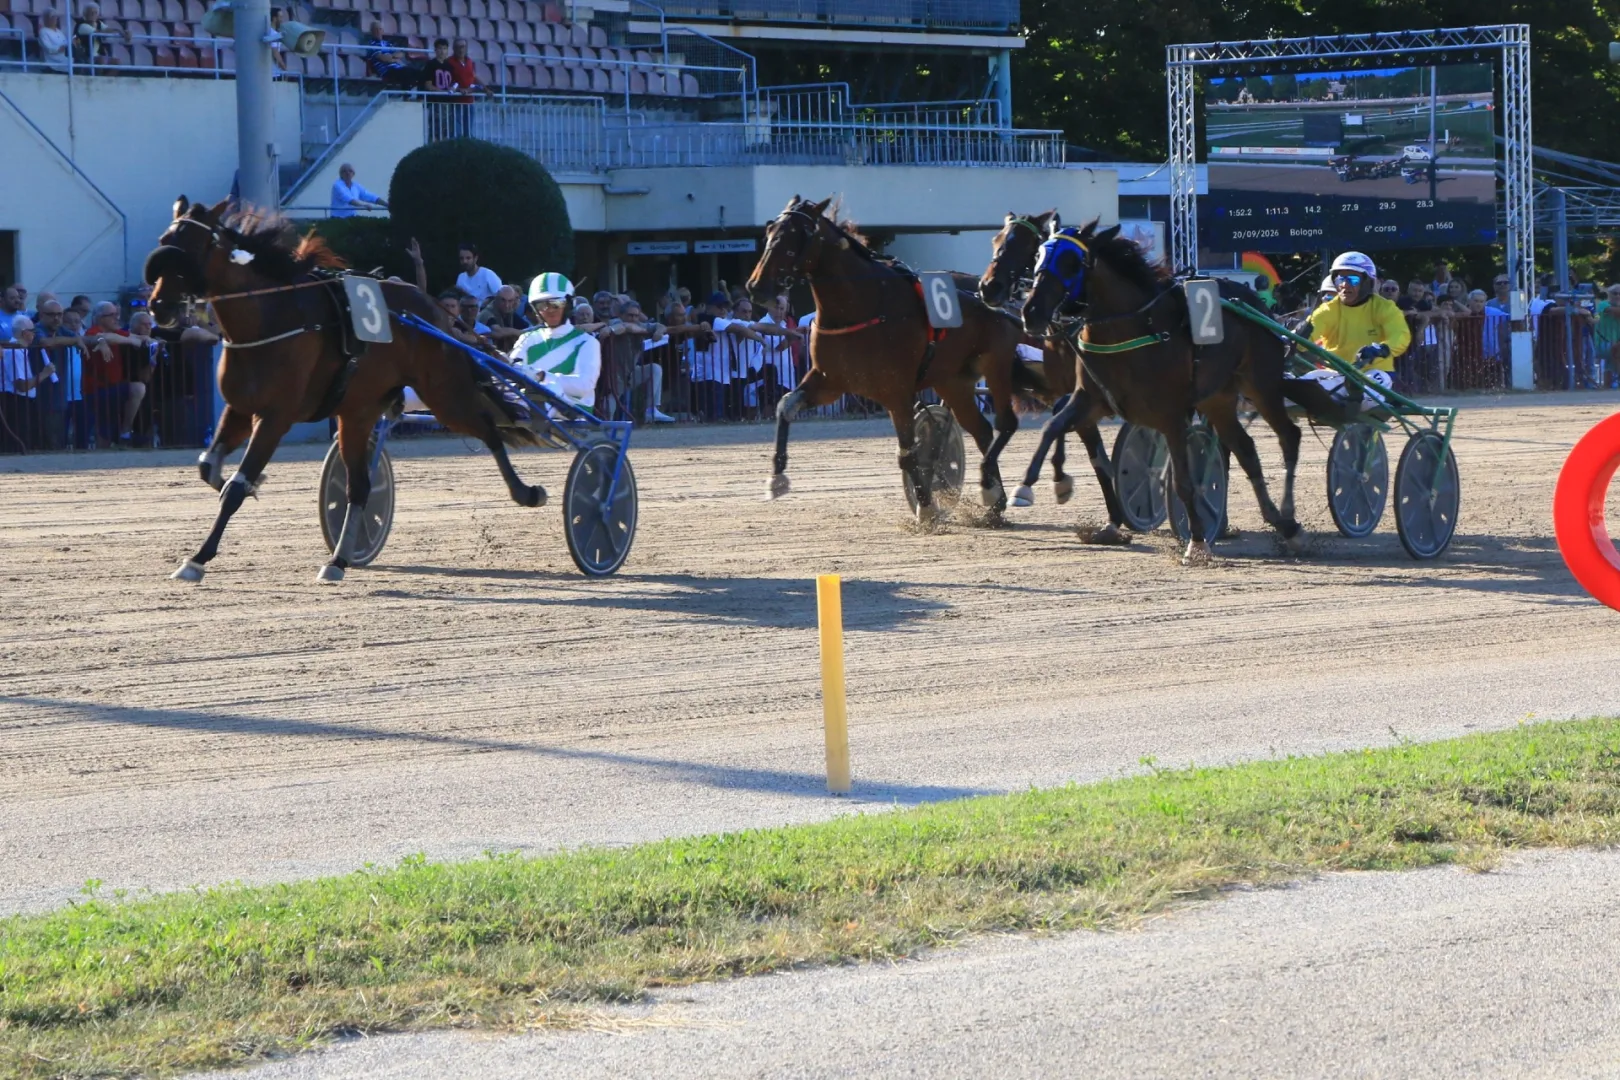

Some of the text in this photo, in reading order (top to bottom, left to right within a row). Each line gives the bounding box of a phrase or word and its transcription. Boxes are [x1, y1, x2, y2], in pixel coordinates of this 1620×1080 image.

[1229, 209, 1252, 217] 1:52.2
[1265, 207, 1289, 215] 1:11.3
[1379, 202, 1396, 210] 29.5
[1416, 200, 1434, 208] 28.3
[1232, 229, 1279, 239] 20/09/2026
[1290, 228, 1323, 237] Bologna
[1435, 222, 1454, 230] 1660
[356, 283, 382, 334] 3
[931, 277, 953, 321] 6
[1195, 287, 1217, 337] 2
